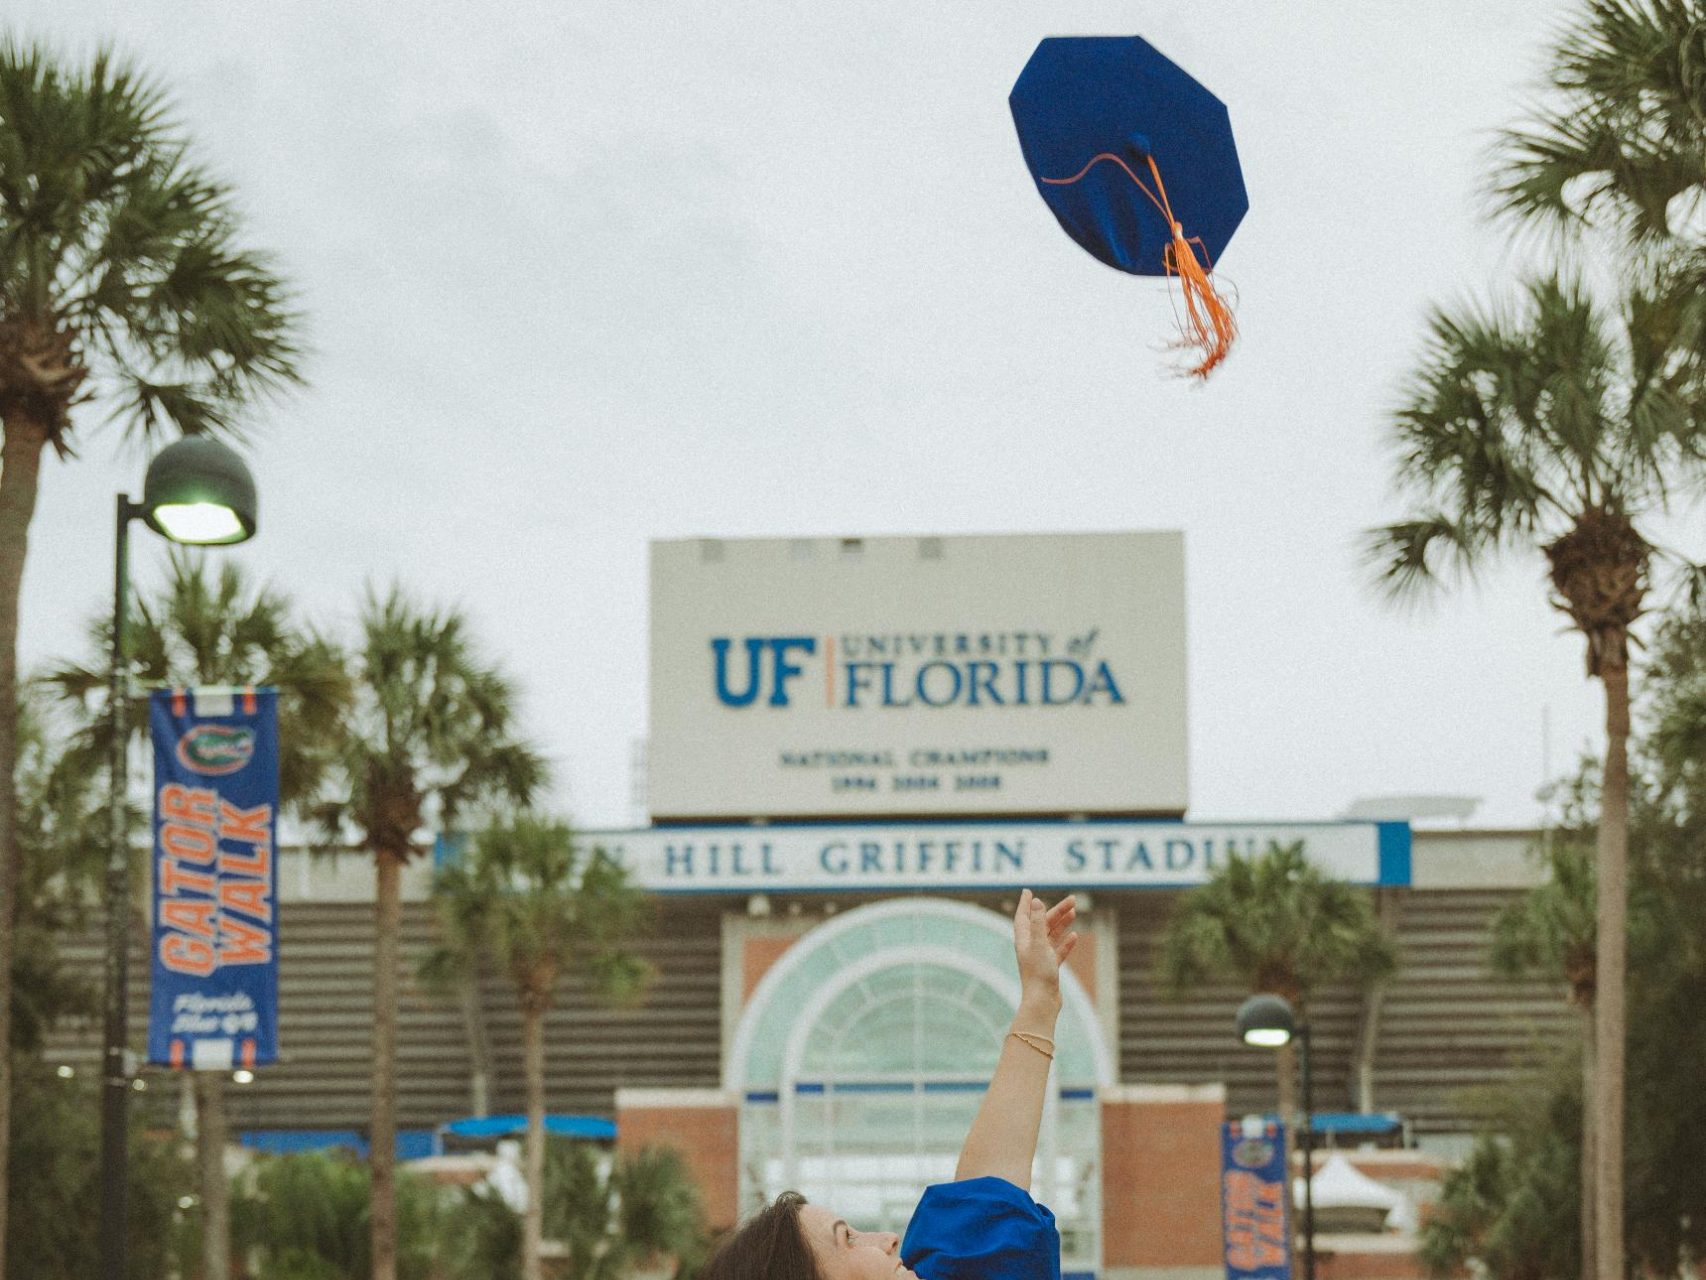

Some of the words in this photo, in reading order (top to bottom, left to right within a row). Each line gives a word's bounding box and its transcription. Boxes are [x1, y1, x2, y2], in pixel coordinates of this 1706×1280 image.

[711, 637, 816, 708] UF
[842, 633, 1053, 657] UNIVERSITY
[1067, 629, 1101, 656] of
[845, 660, 1126, 707] FLORIDA
[159, 782, 218, 977] GATOR
[216, 798, 273, 966] WALK
[664, 842, 781, 876] HILL
[818, 840, 1026, 874] GRIFFIN
